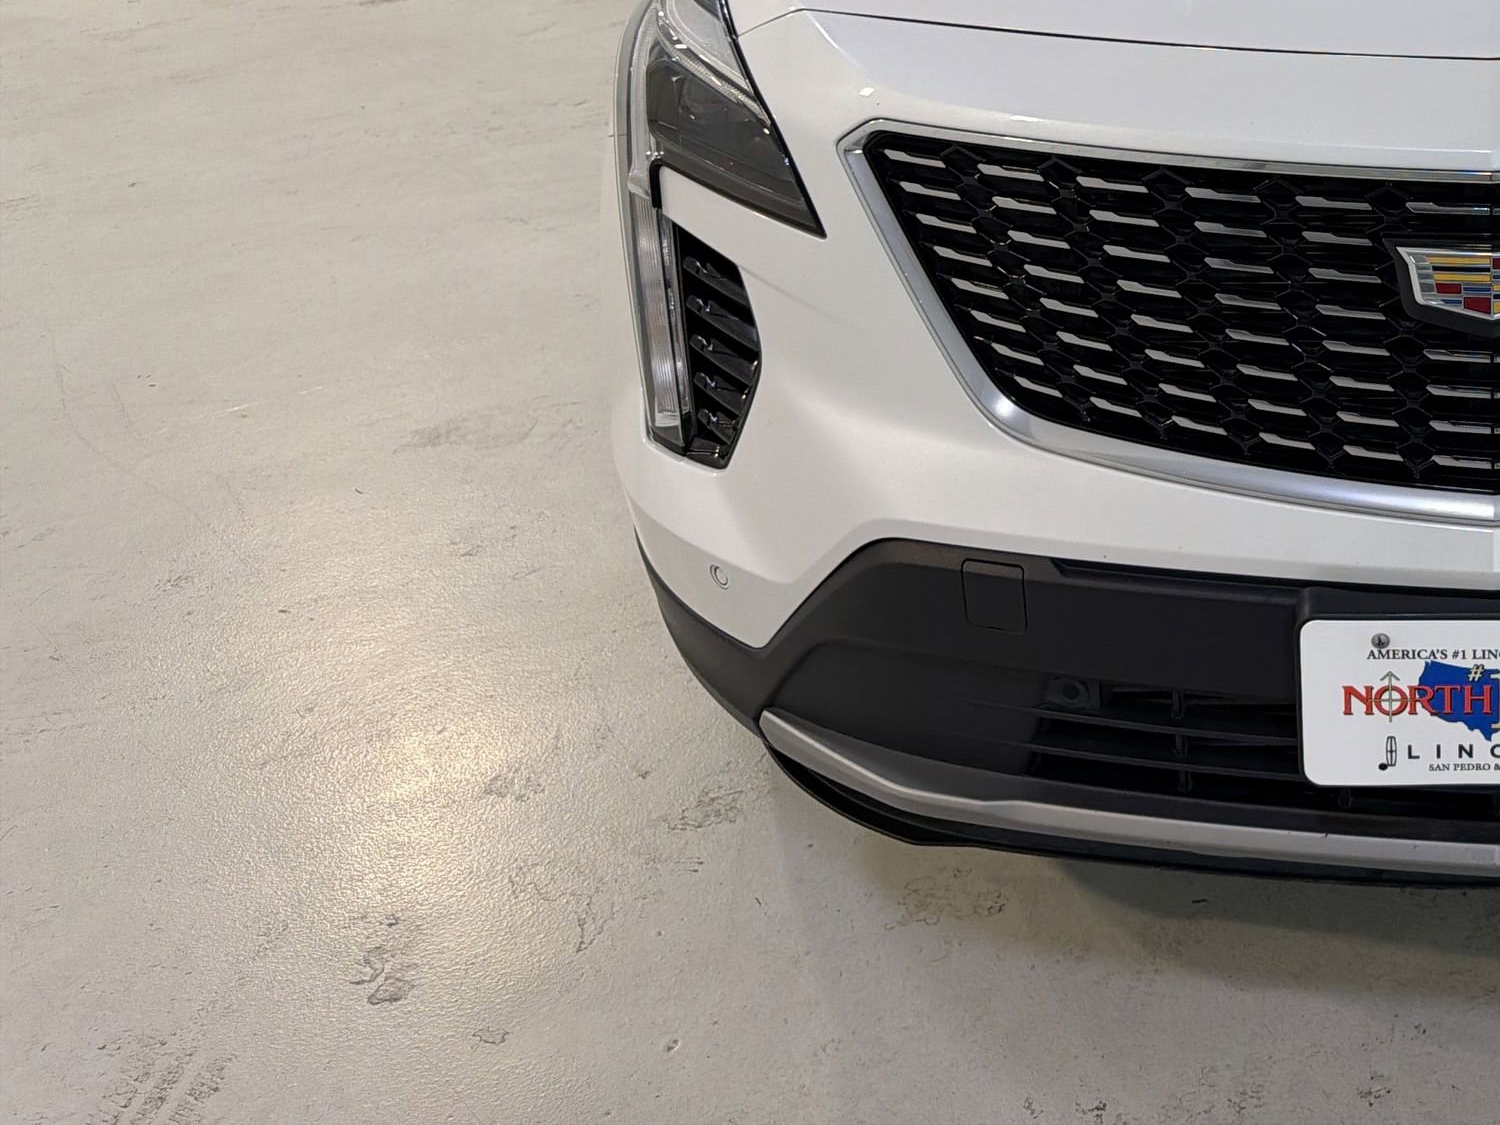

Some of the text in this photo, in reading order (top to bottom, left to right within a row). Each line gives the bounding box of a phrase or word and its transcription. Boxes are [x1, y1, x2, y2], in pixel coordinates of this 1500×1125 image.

[1366, 649, 1448, 660] AMERICA'S
[1451, 649, 1468, 660] #1
[1341, 685, 1493, 716] NORTH
[1428, 763, 1450, 772] SAN
[1453, 763, 1491, 772] PEDRO
